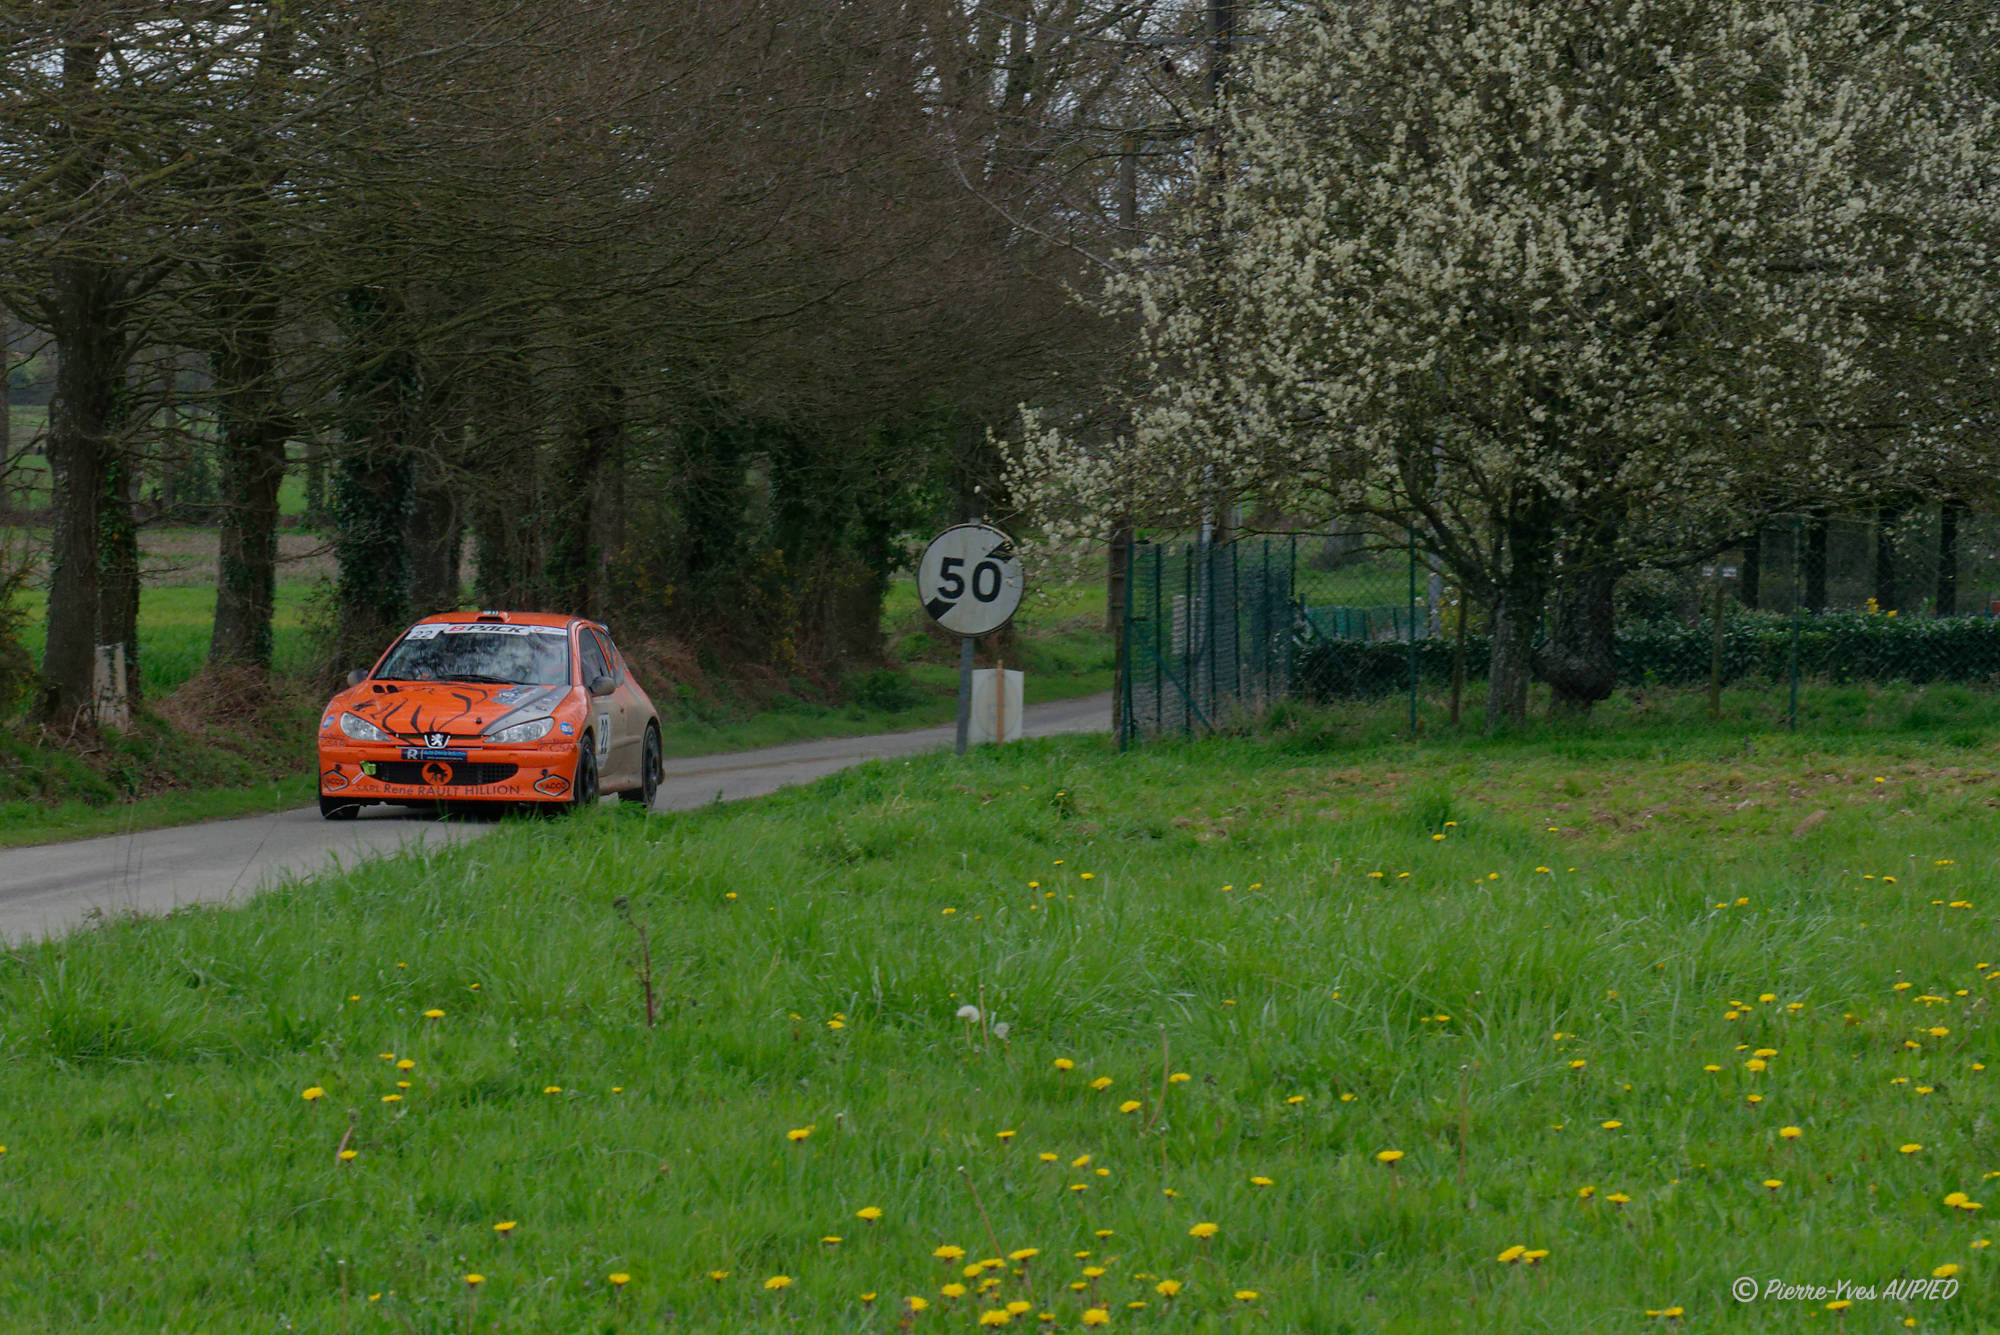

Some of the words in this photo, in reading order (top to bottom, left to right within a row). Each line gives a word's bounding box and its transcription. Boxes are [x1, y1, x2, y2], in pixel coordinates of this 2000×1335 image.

[938, 557, 1001, 602] 50
[411, 631, 432, 639] 22
[600, 719, 609, 755] 22
[418, 785, 459, 797] RAULT
[464, 785, 520, 796] HILLION
